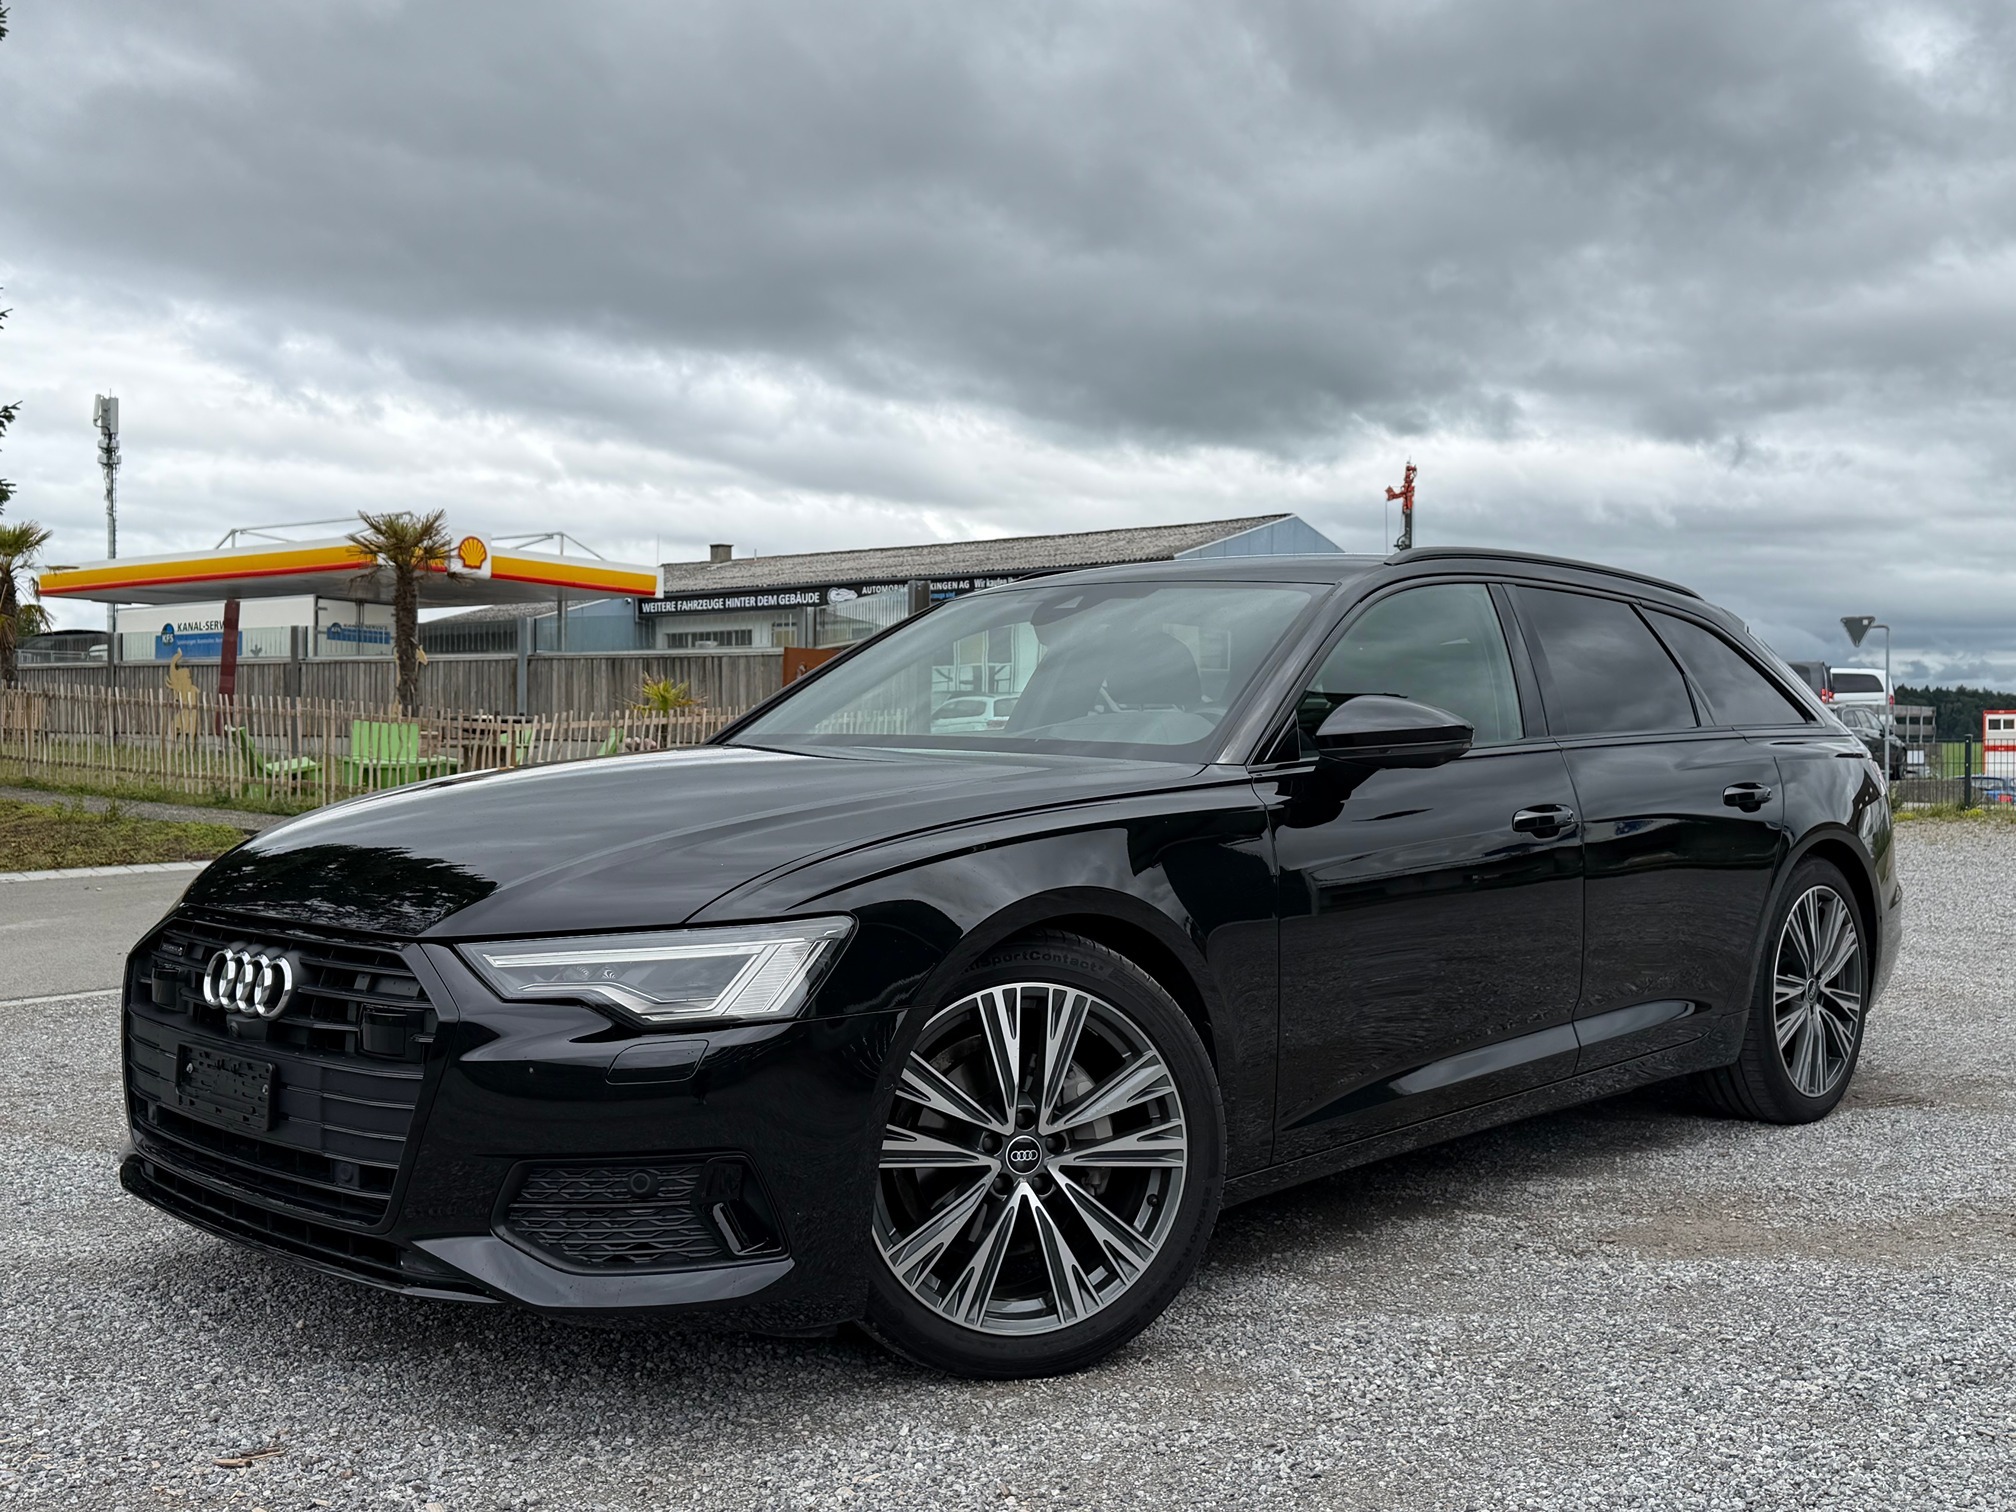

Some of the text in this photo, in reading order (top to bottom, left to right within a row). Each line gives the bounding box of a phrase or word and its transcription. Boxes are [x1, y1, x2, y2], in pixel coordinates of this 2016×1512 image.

[959, 580, 970, 589] AG
[642, 591, 820, 613] WEITERE FAHRZEUGE HINTER DEM GEBÄUDE
[162, 633, 174, 643] KFS
